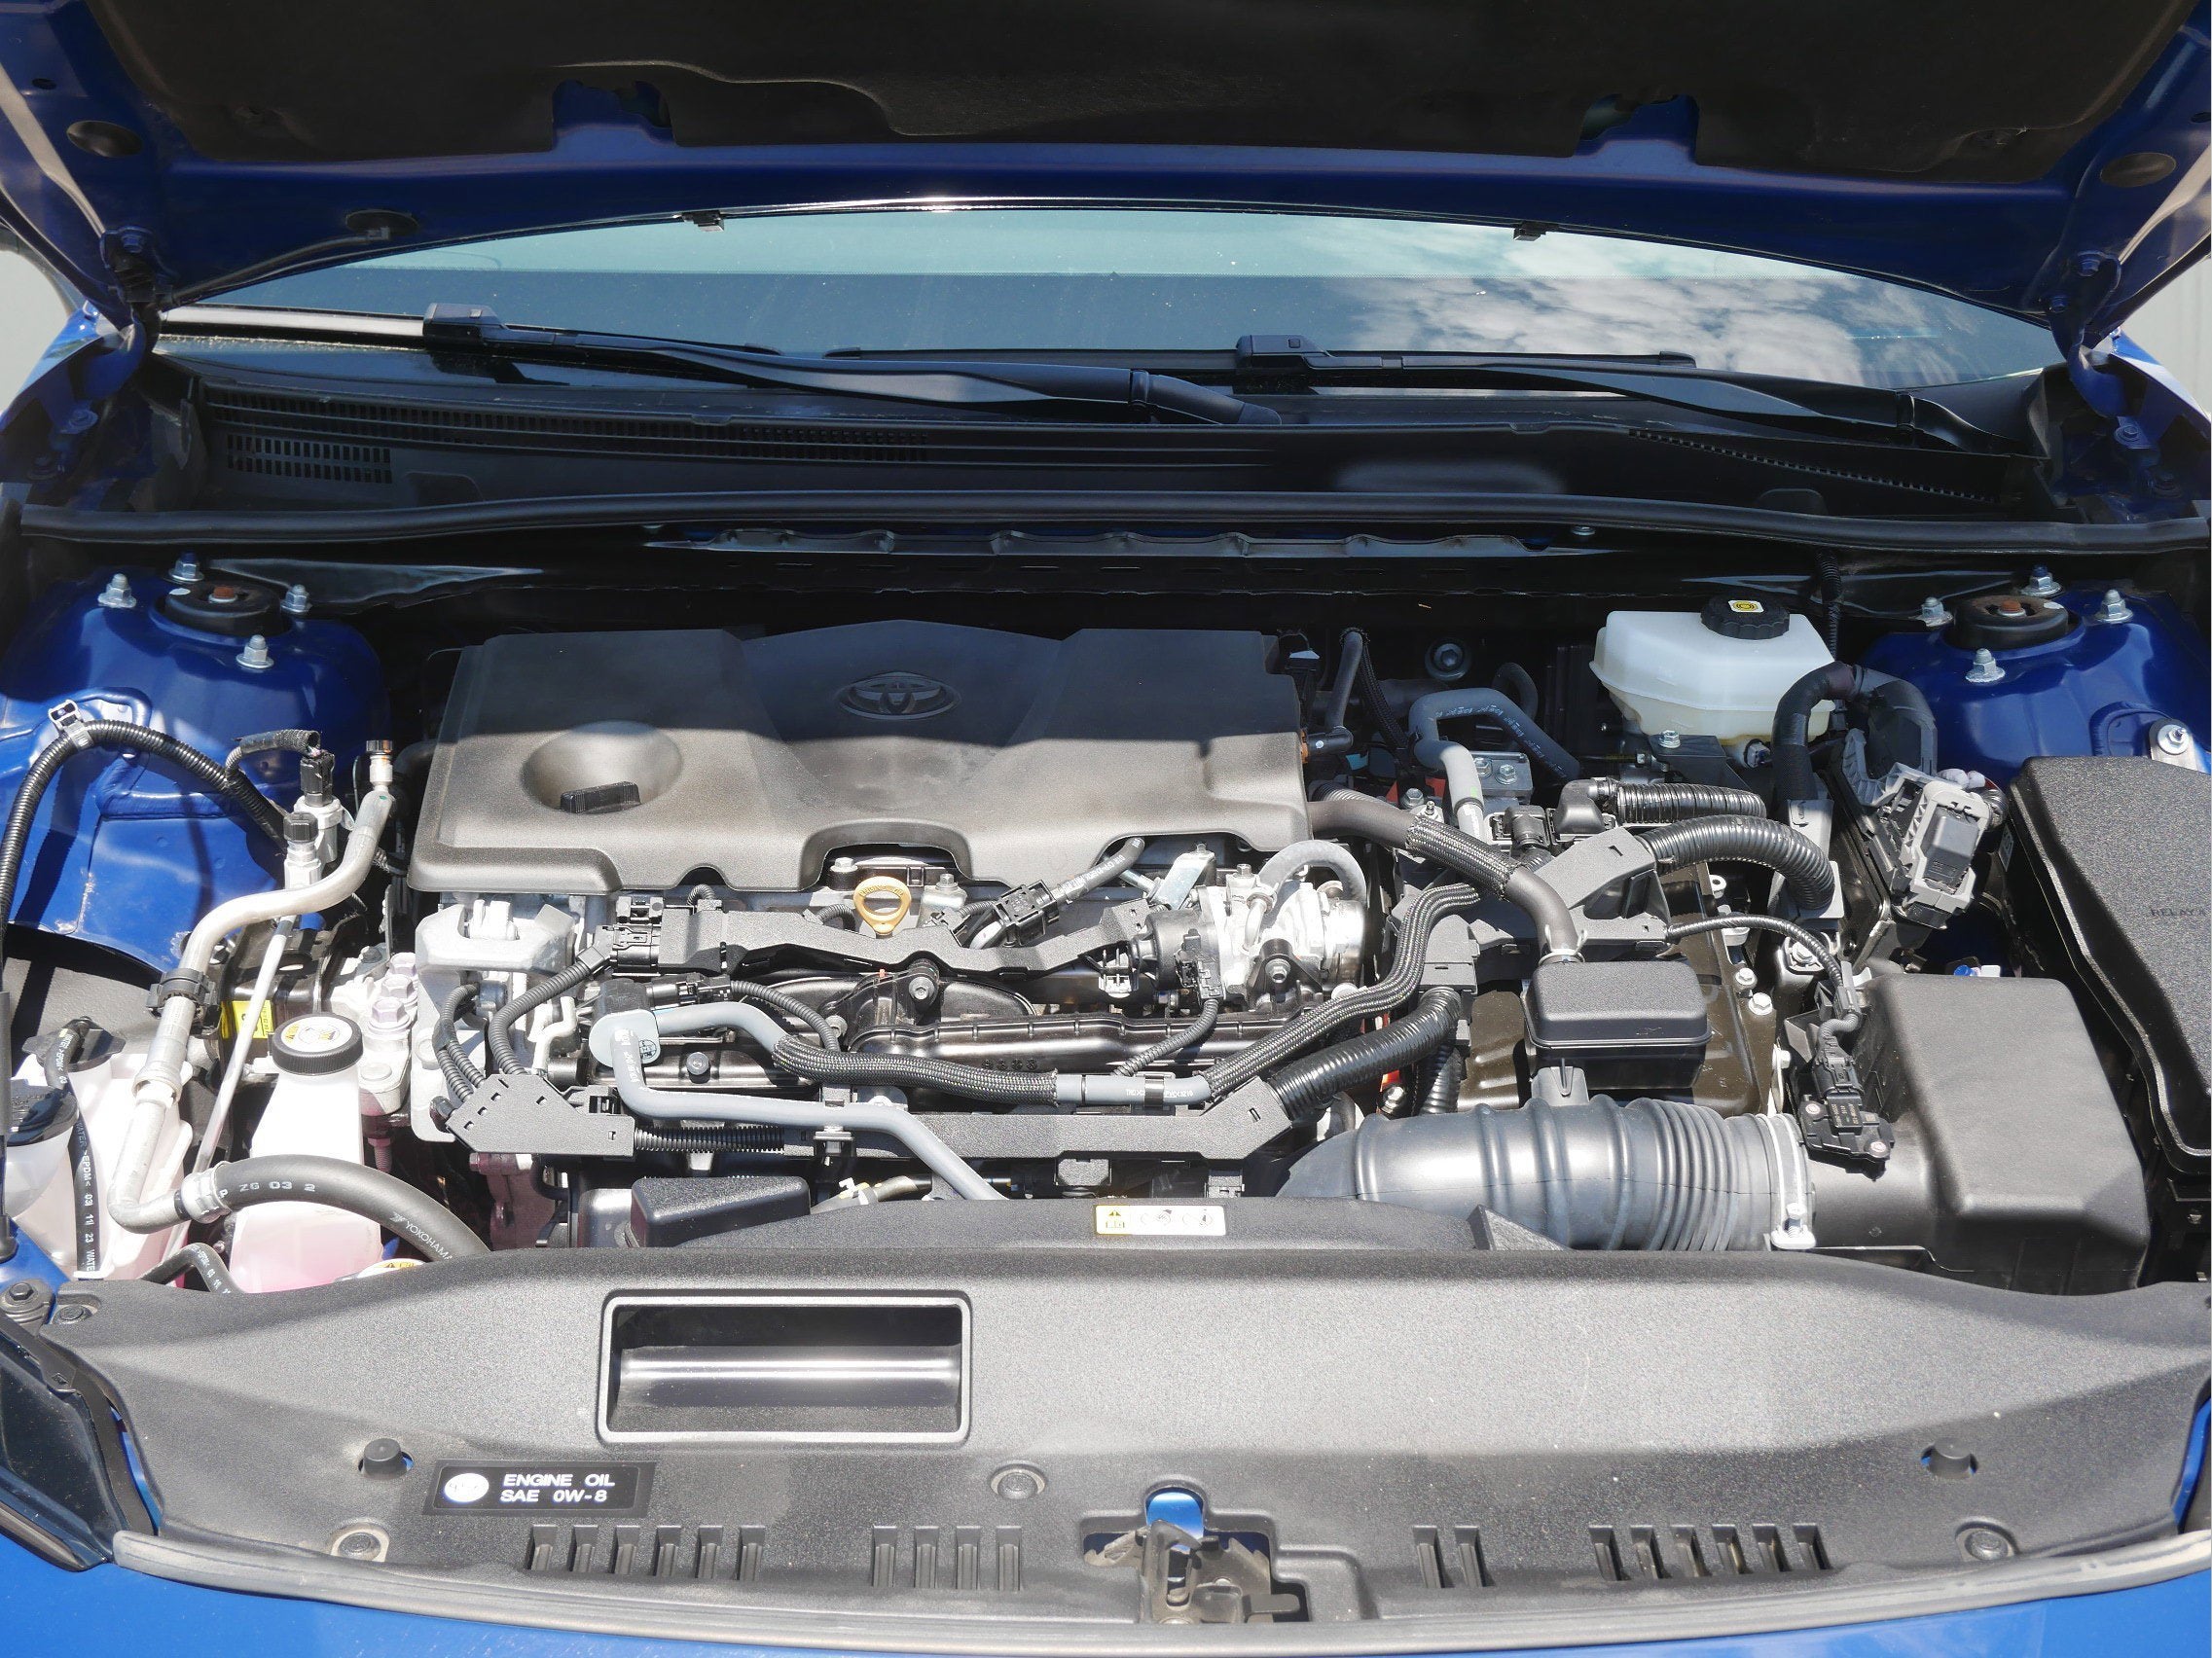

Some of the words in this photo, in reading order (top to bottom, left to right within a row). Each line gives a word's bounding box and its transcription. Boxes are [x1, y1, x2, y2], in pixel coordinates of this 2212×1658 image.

[86, 1249, 96, 1272] WATE
[502, 1473, 573, 1487] ENGINE
[584, 1473, 615, 1487] OIL
[499, 1489, 541, 1502] SAE
